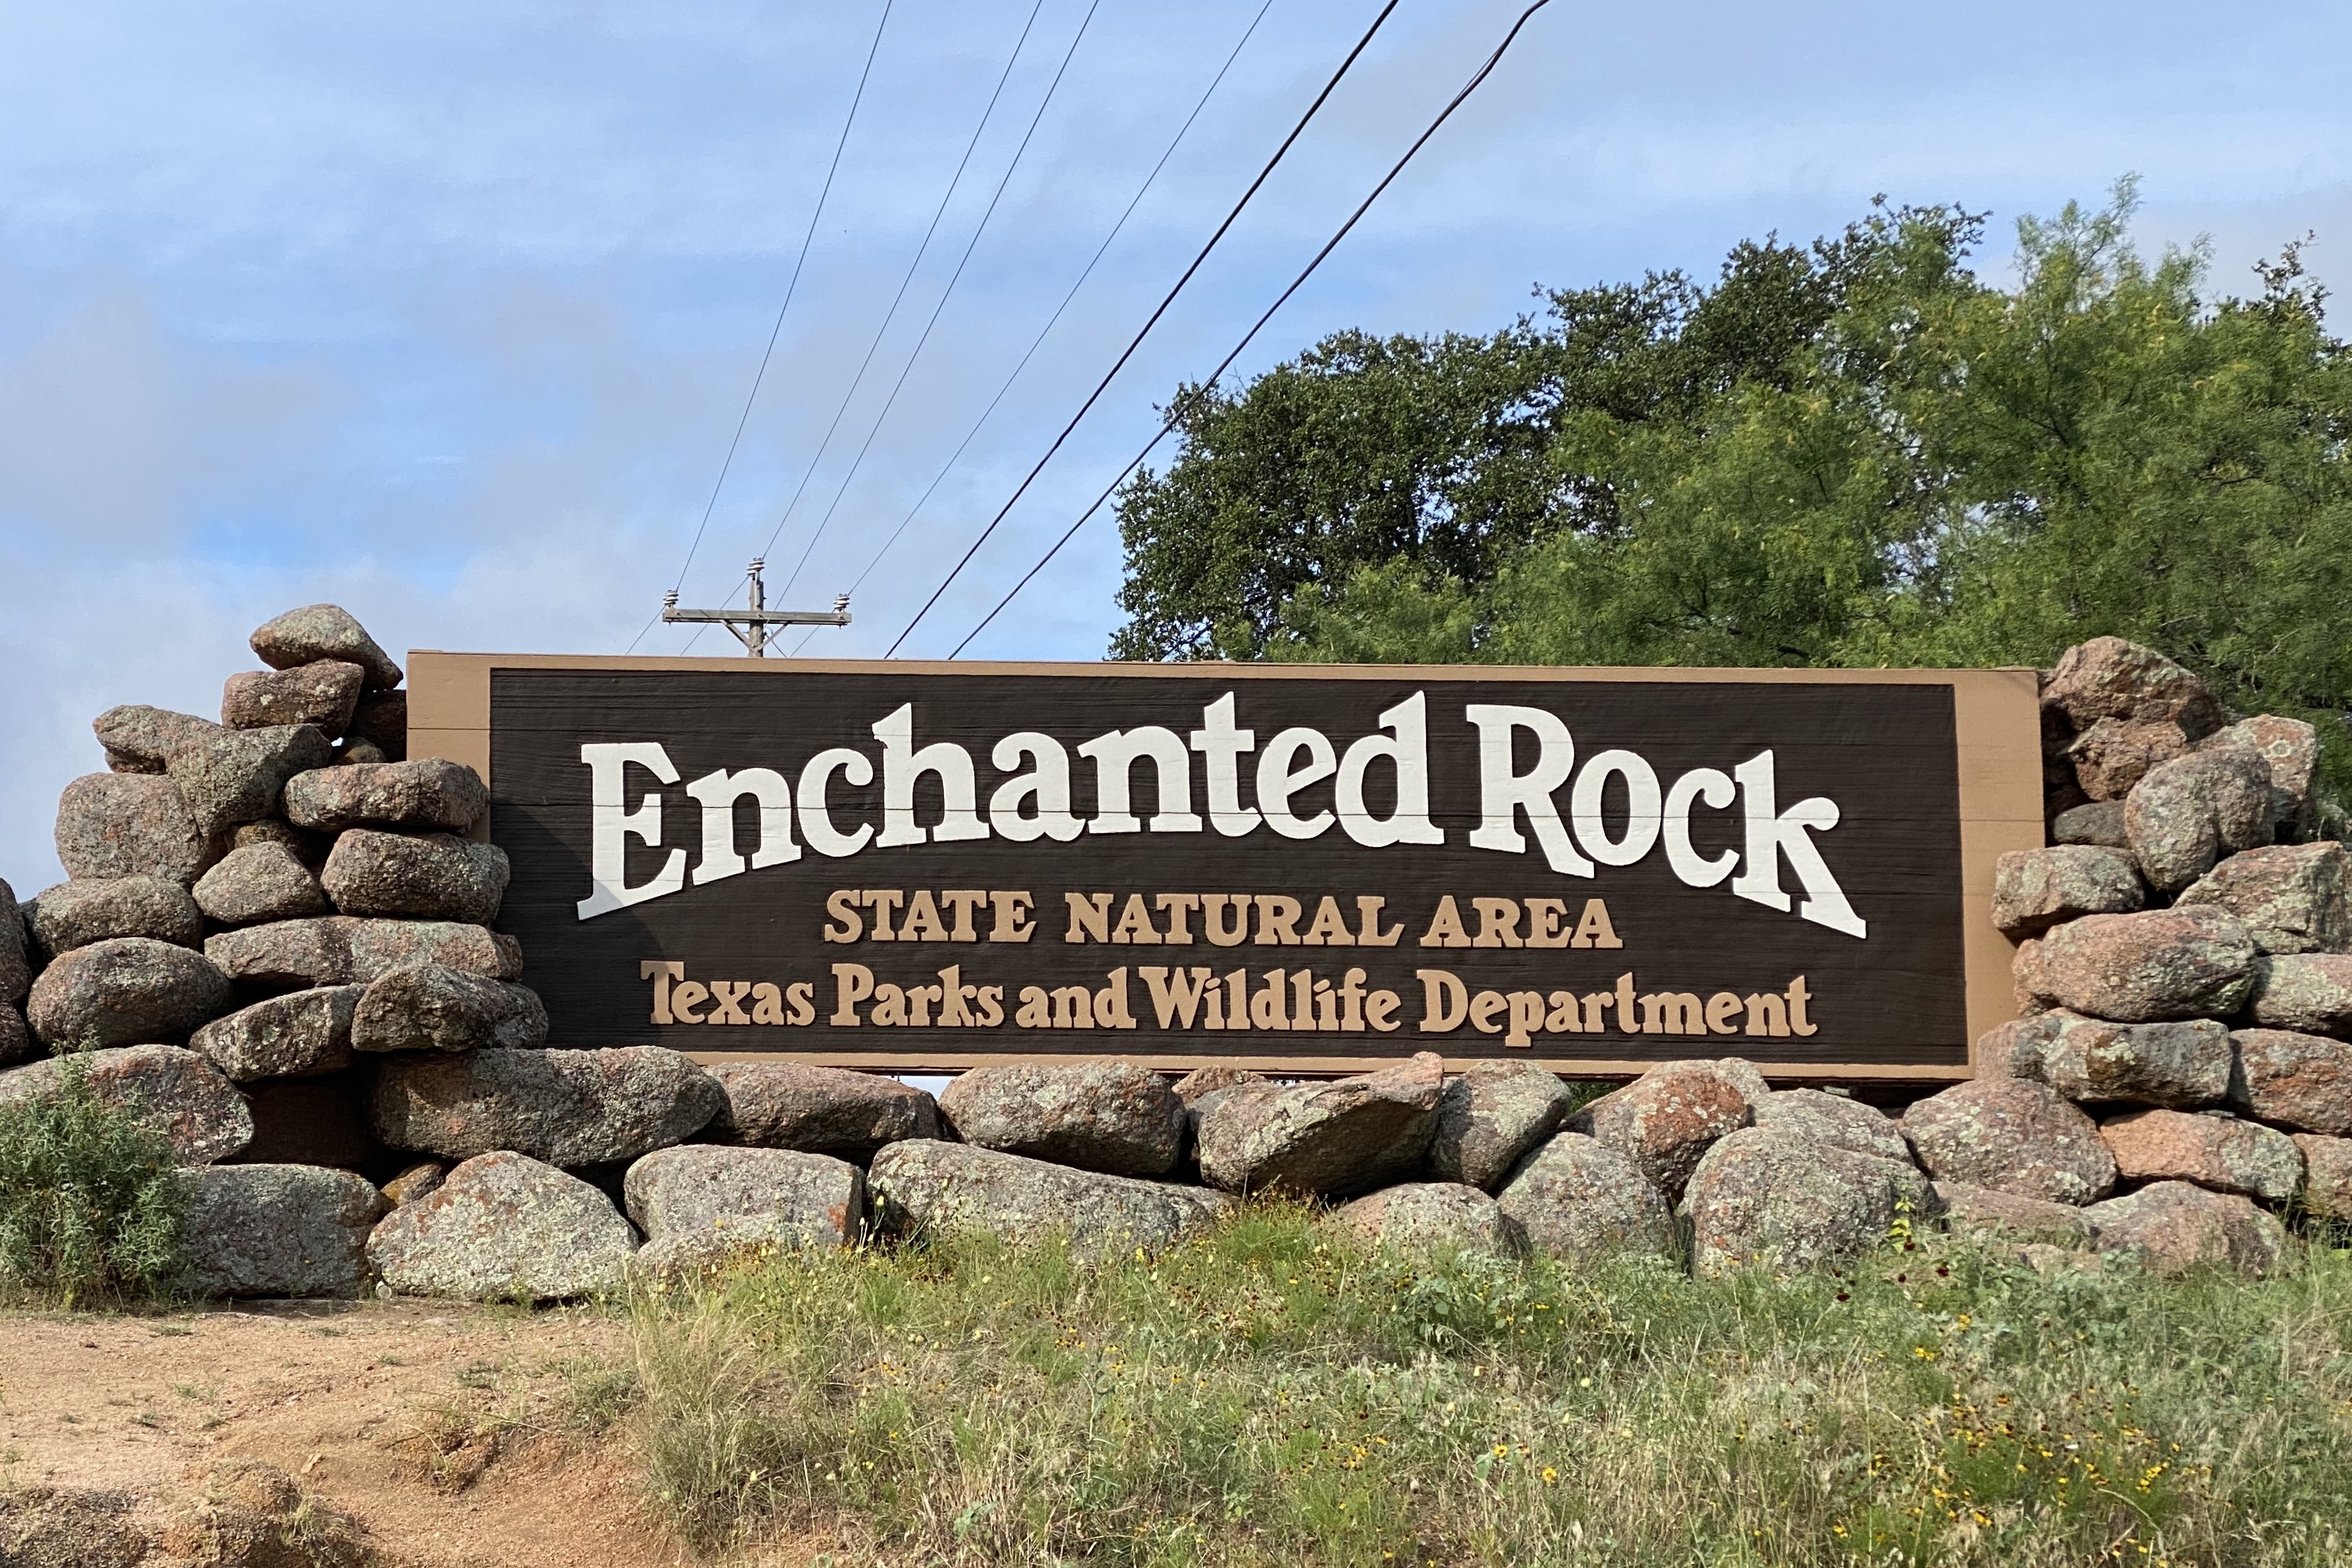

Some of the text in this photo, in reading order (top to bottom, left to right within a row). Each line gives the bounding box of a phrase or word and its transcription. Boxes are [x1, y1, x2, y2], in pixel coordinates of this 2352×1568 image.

[577, 690, 1866, 938] Enchanted Rock
[825, 890, 1623, 948] STATE NATURAL AREA
[641, 961, 1817, 1047] Texas Parks and Wildlife Department
